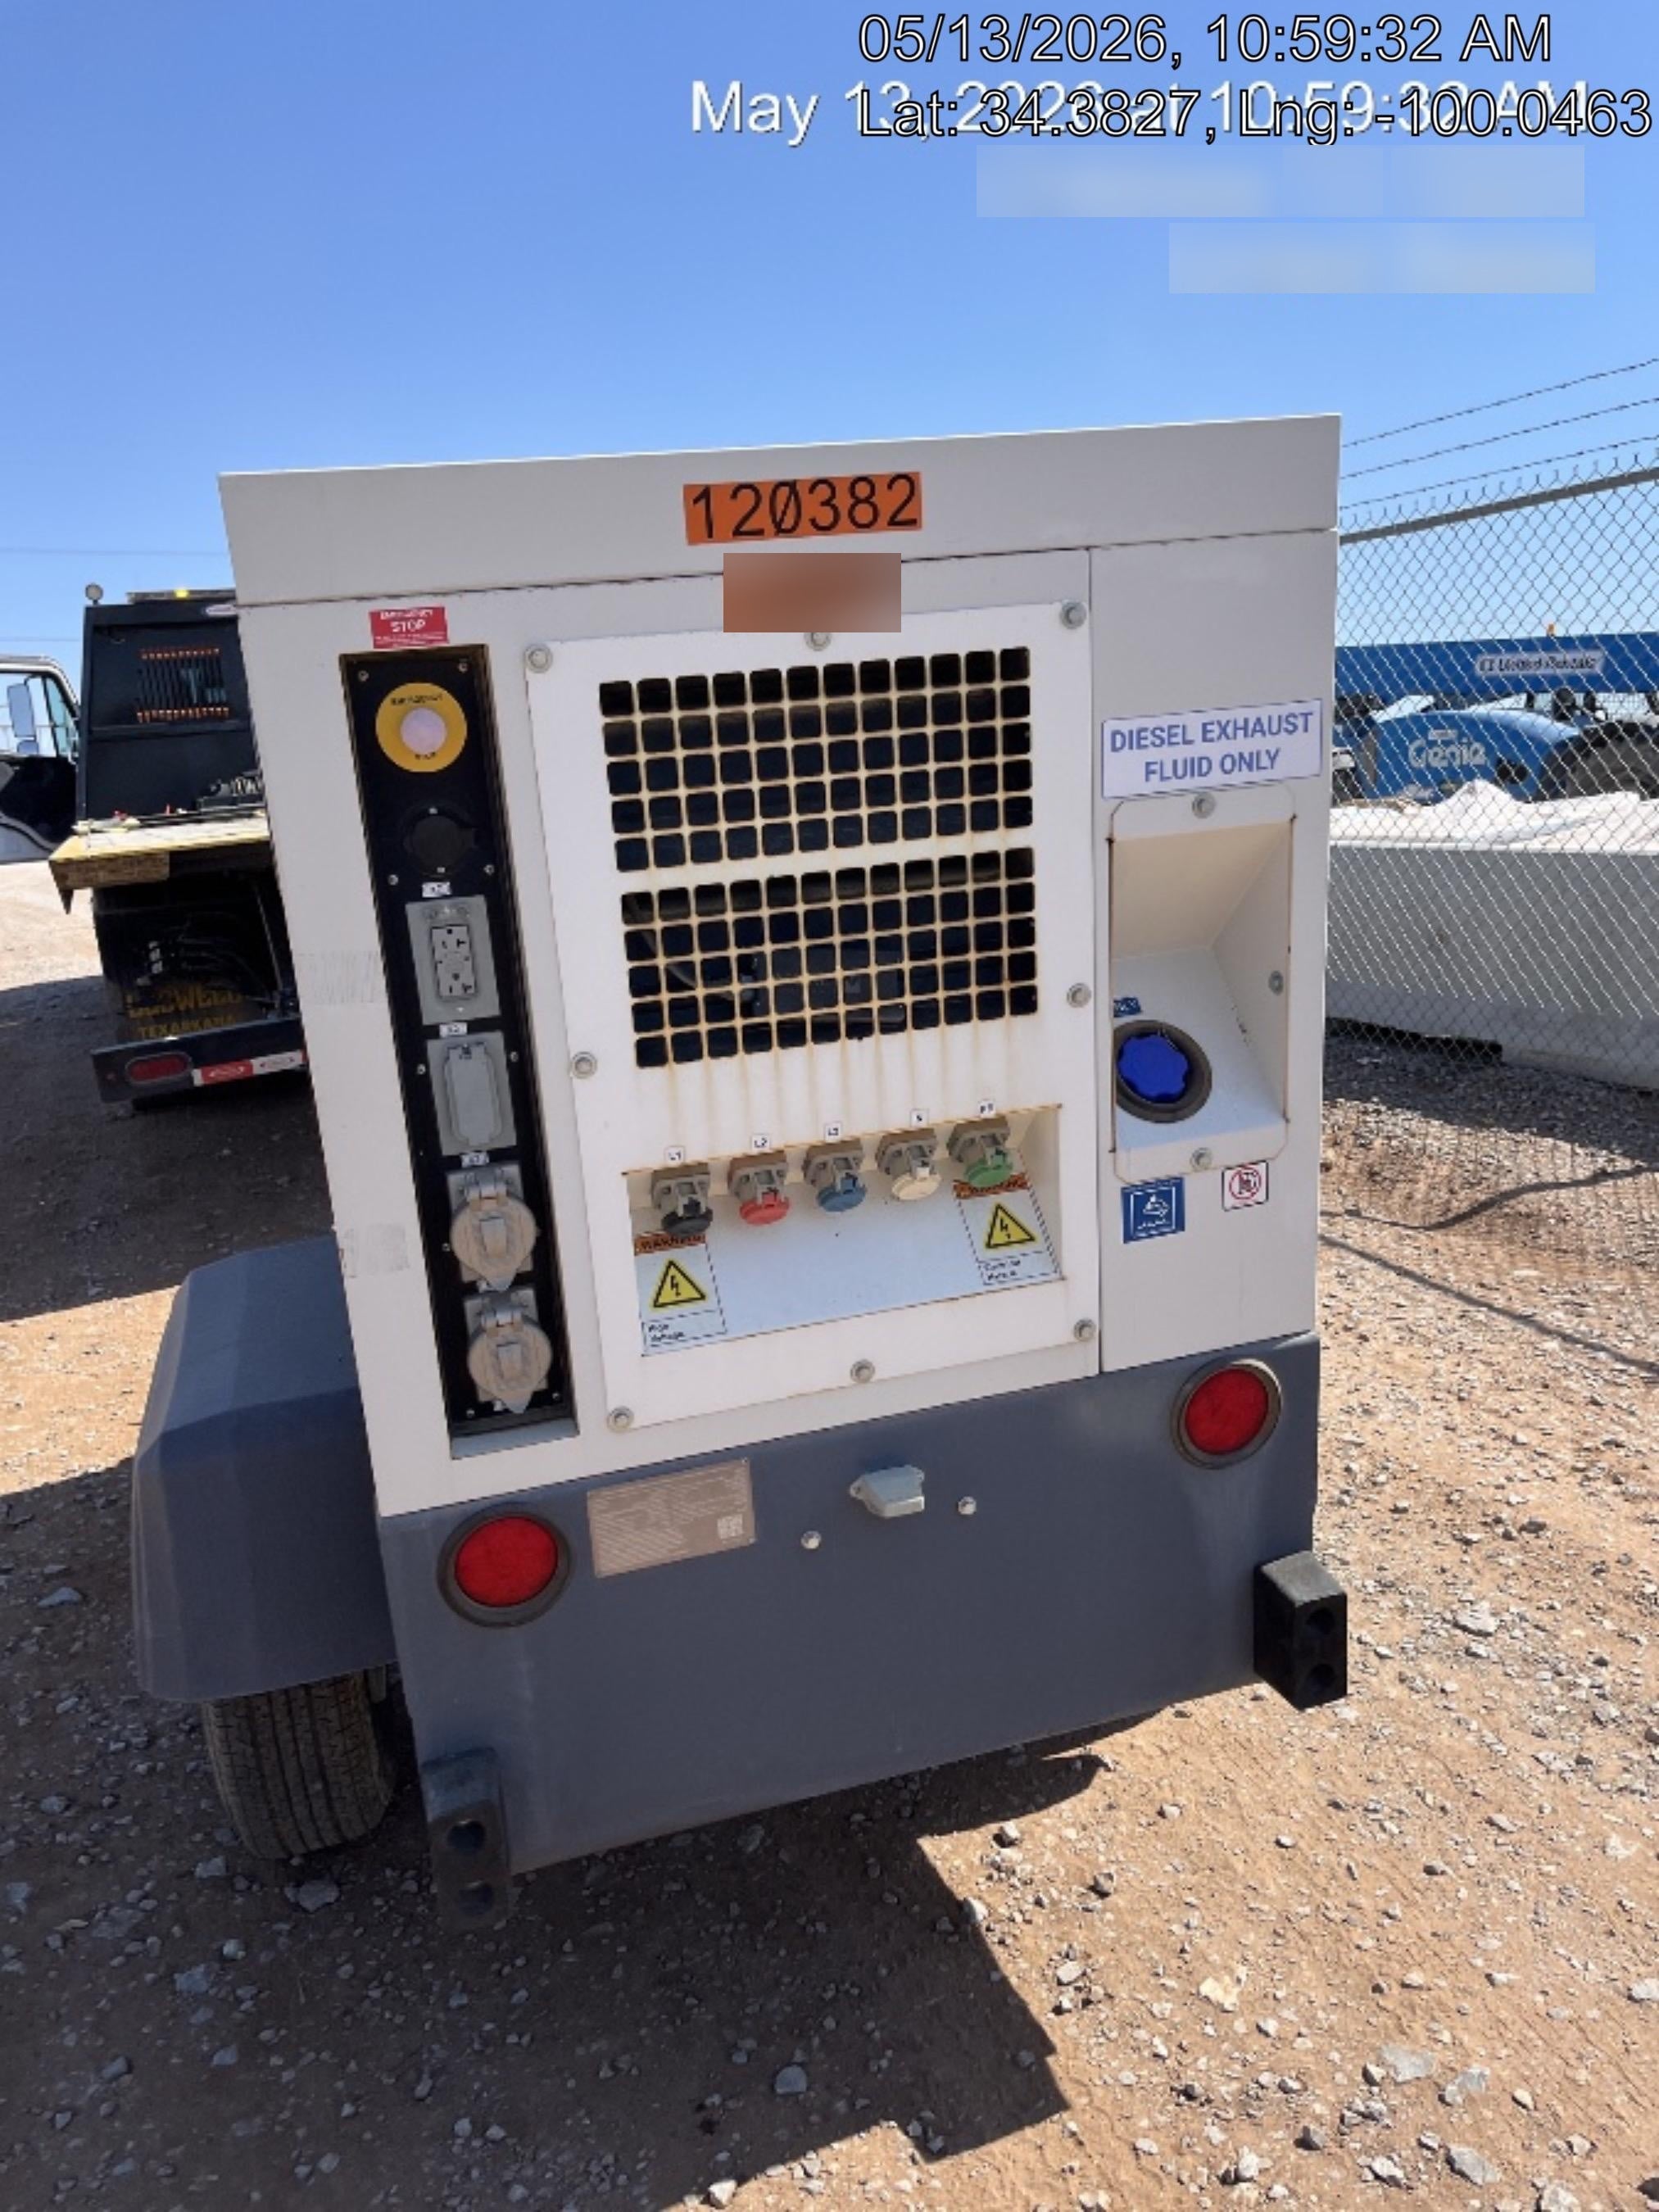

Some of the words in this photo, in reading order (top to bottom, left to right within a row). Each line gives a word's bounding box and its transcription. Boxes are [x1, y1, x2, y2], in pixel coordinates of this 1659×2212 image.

[692, 473, 918, 539] 120382
[390, 619, 425, 632] STOP
[1110, 724, 1194, 752] DIESEL
[1201, 712, 1313, 744] EXHAUST
[1145, 755, 1213, 782] FLUID
[1219, 747, 1281, 776] ONLY
[754, 1137, 768, 1148] L2
